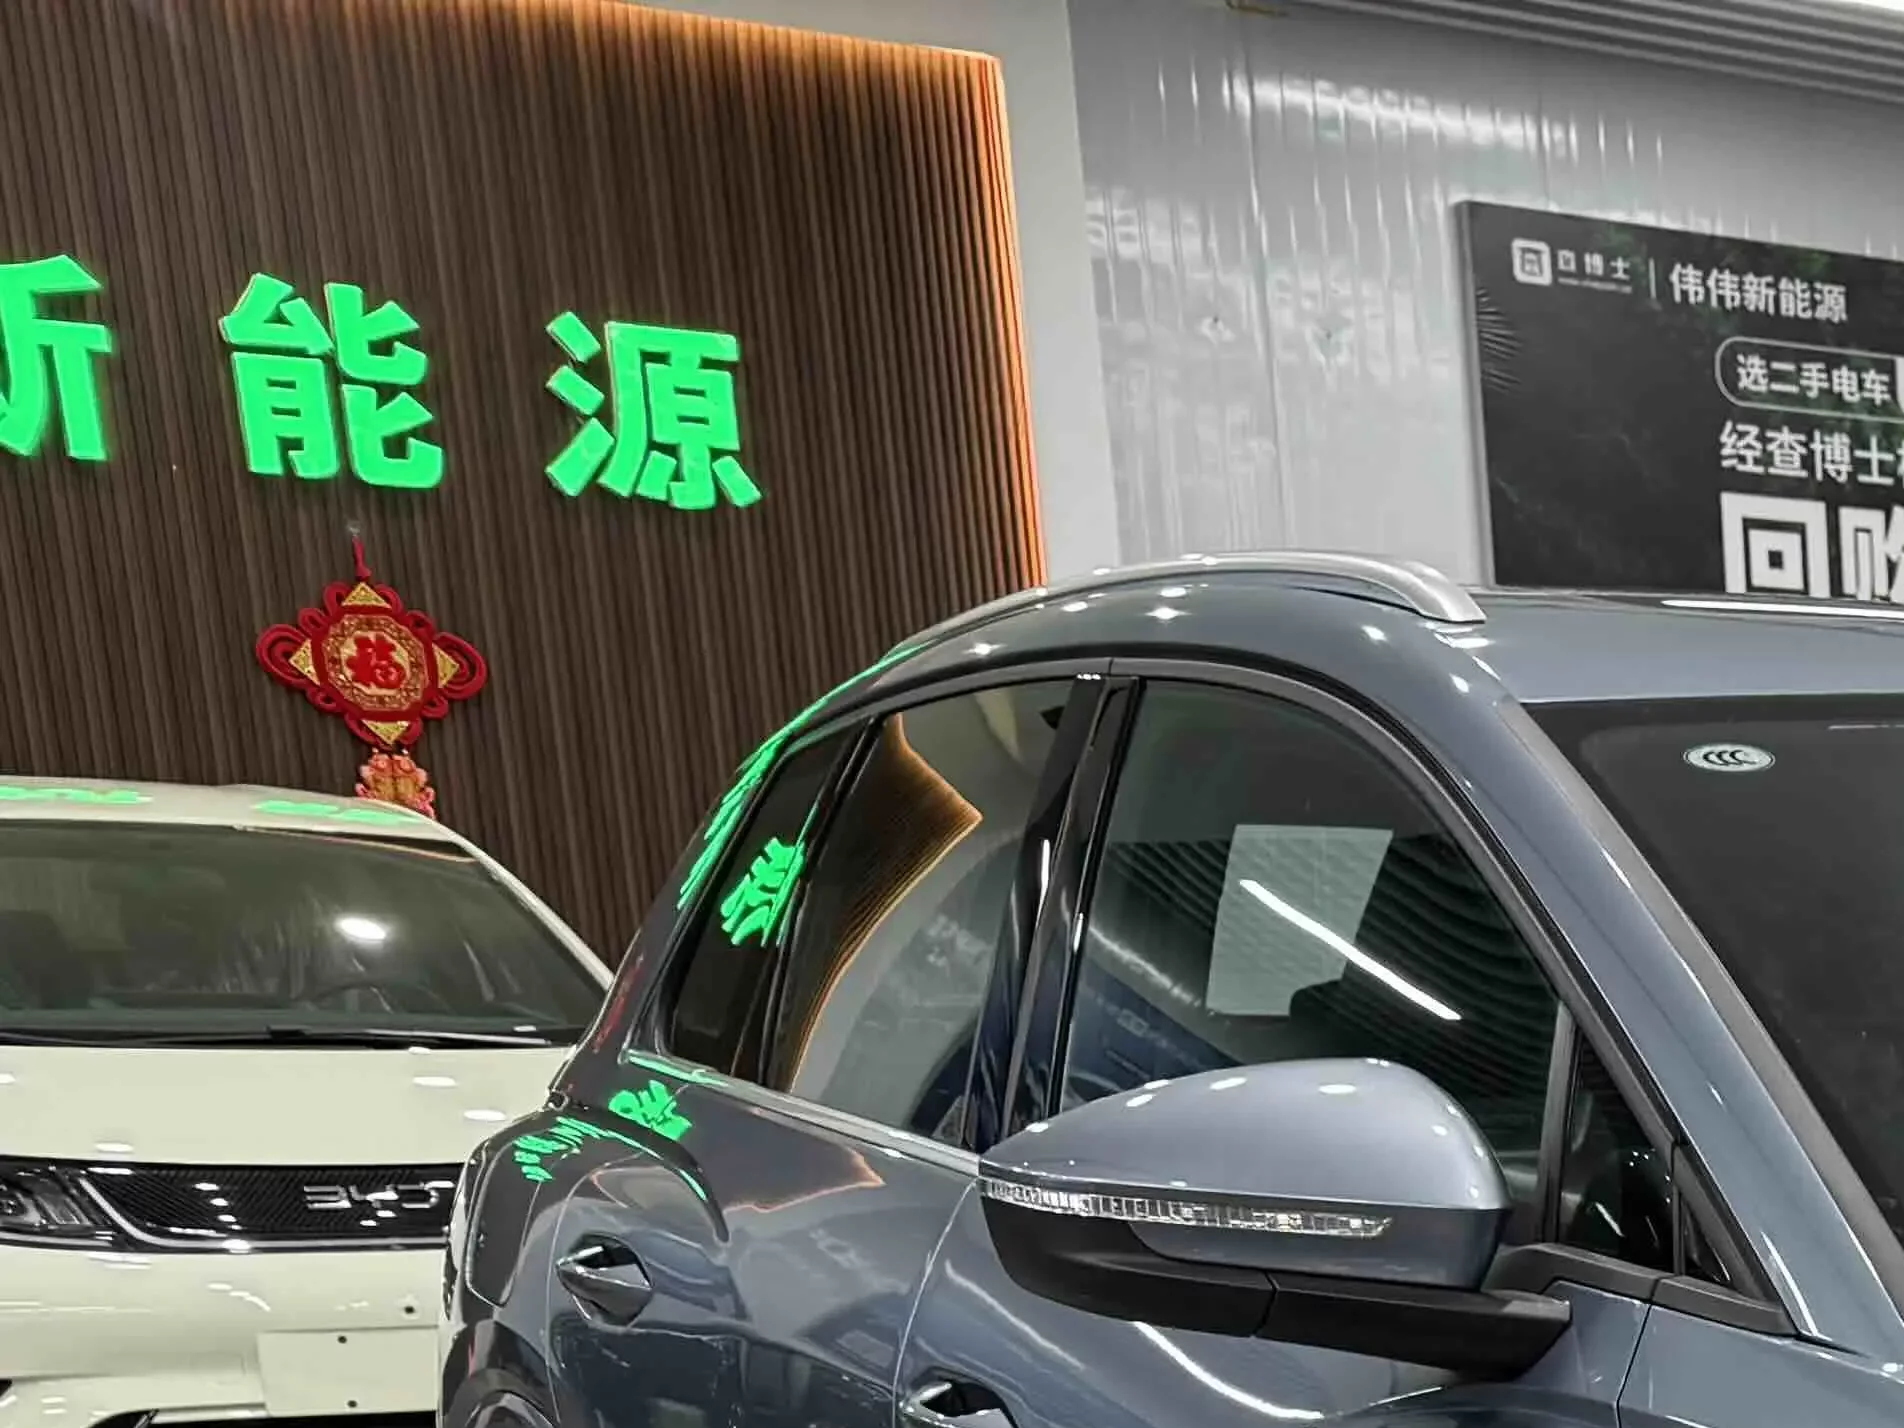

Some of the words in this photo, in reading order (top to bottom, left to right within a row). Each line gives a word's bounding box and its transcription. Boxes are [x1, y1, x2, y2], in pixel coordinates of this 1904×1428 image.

[1668, 261, 1848, 324] 伟伟新能源
[1735, 352, 1893, 406] 选二手电车
